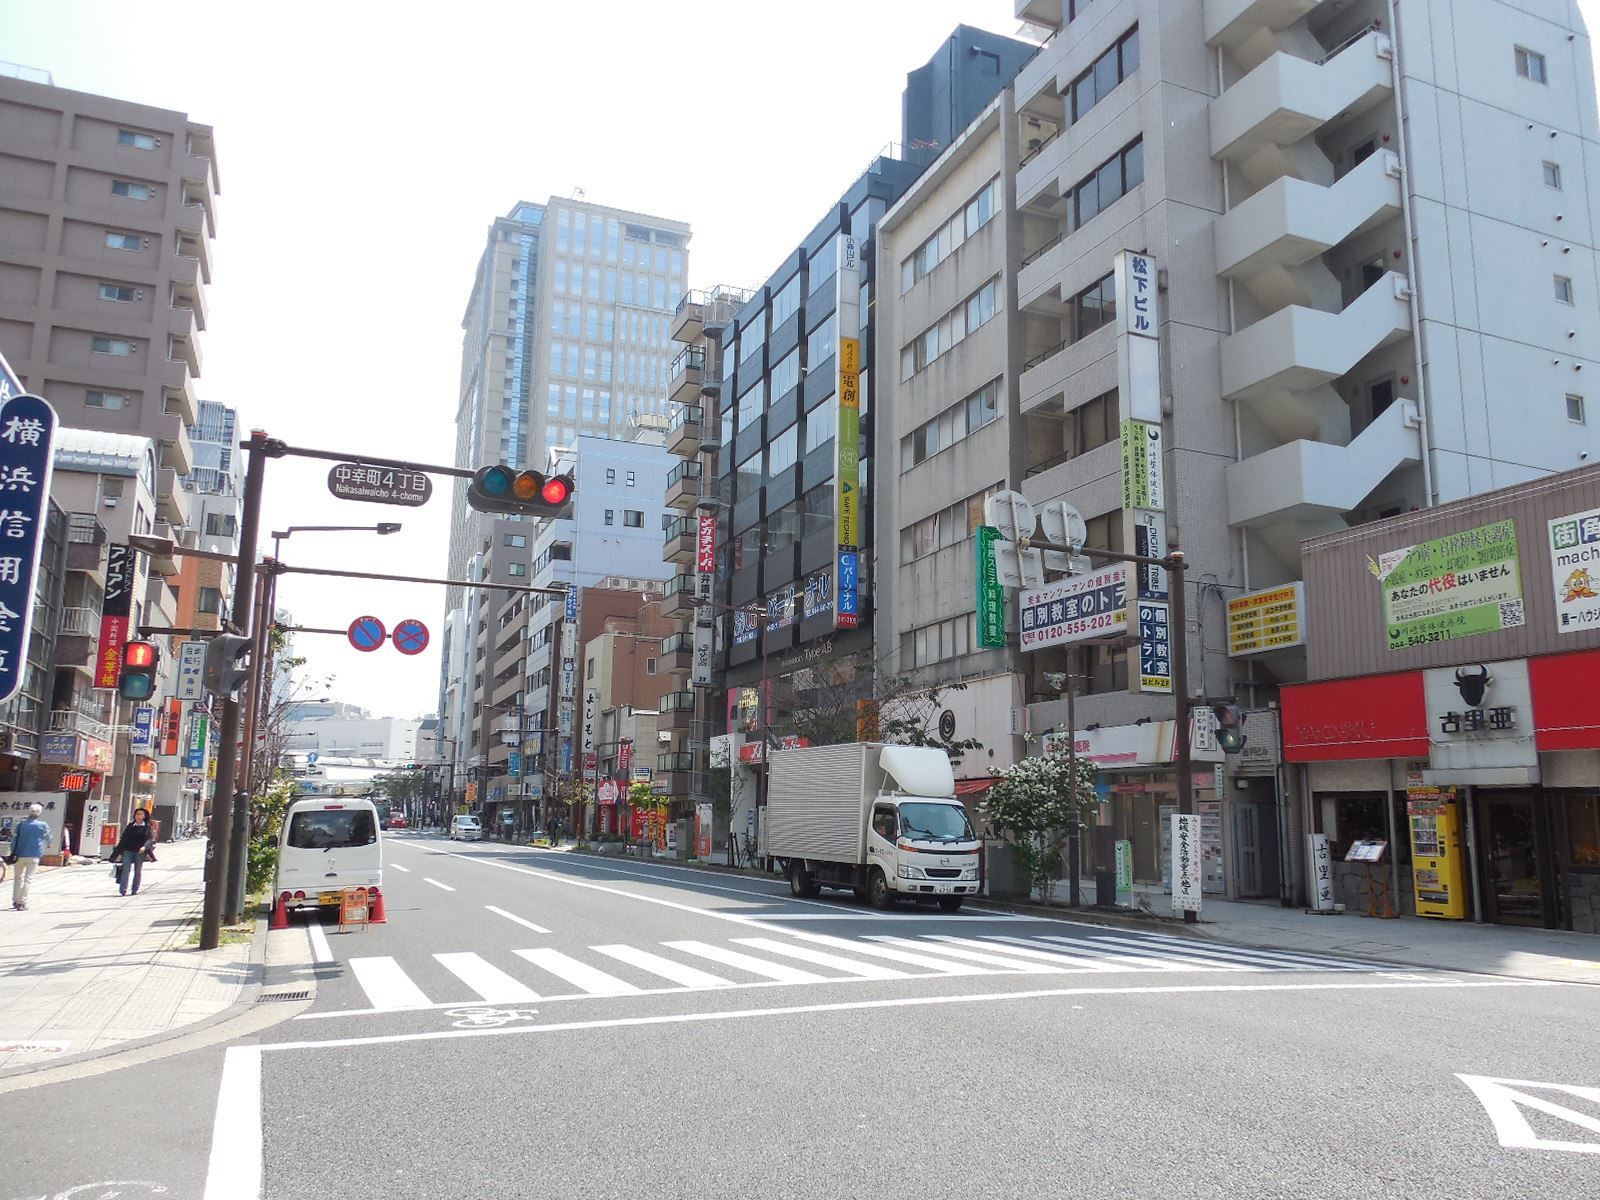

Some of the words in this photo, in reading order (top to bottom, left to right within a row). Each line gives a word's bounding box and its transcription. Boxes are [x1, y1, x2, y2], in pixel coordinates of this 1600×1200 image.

[1132, 256, 1149, 331] 松下ビル
[335, 483, 389, 498] Nakasaiwaicho
[391, 489, 424, 502] 4-chome
[336, 465, 426, 491] 中幸町4丁目
[700, 517, 713, 573] メガネスーパー
[1150, 528, 1158, 559] DIGITA
[1557, 546, 1600, 567] mach
[105, 546, 126, 600] アイアン
[843, 566, 852, 611] パーソナル
[1391, 564, 1511, 601] あなたの代役はいません
[1023, 585, 1126, 629] 個別教室のトラ
[1141, 608, 1153, 673] のトライ
[1154, 609, 1168, 675] 個別教室
[1389, 629, 1451, 650] 044-540-3211
[584, 692, 594, 749] よしもと
